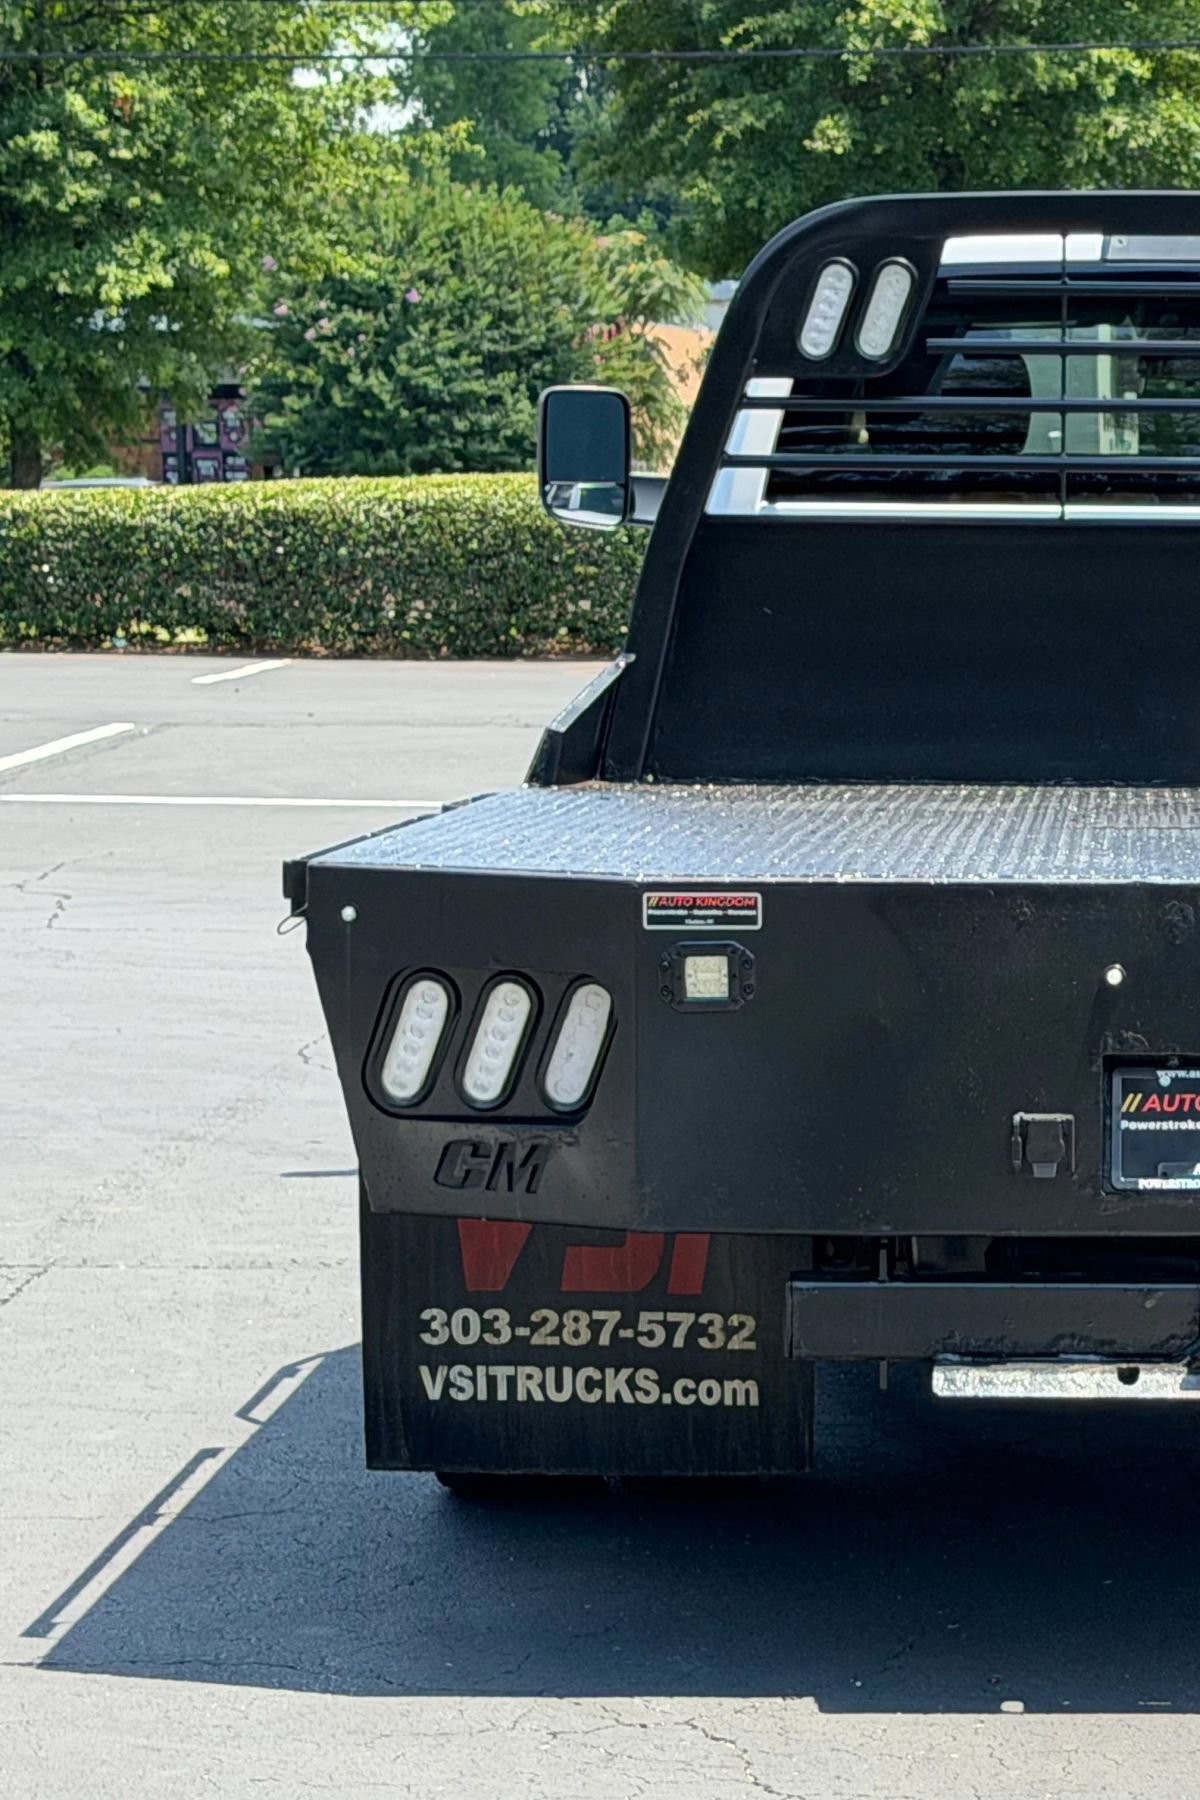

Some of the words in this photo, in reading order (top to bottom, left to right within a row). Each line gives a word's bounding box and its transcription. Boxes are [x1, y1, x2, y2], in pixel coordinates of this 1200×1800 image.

[659, 896, 693, 907] AUTO
[696, 896, 755, 907] KINGDOM
[419, 1308, 757, 1350] 303-287-5732
[418, 1364, 760, 1406] VSITRUCKS.com
